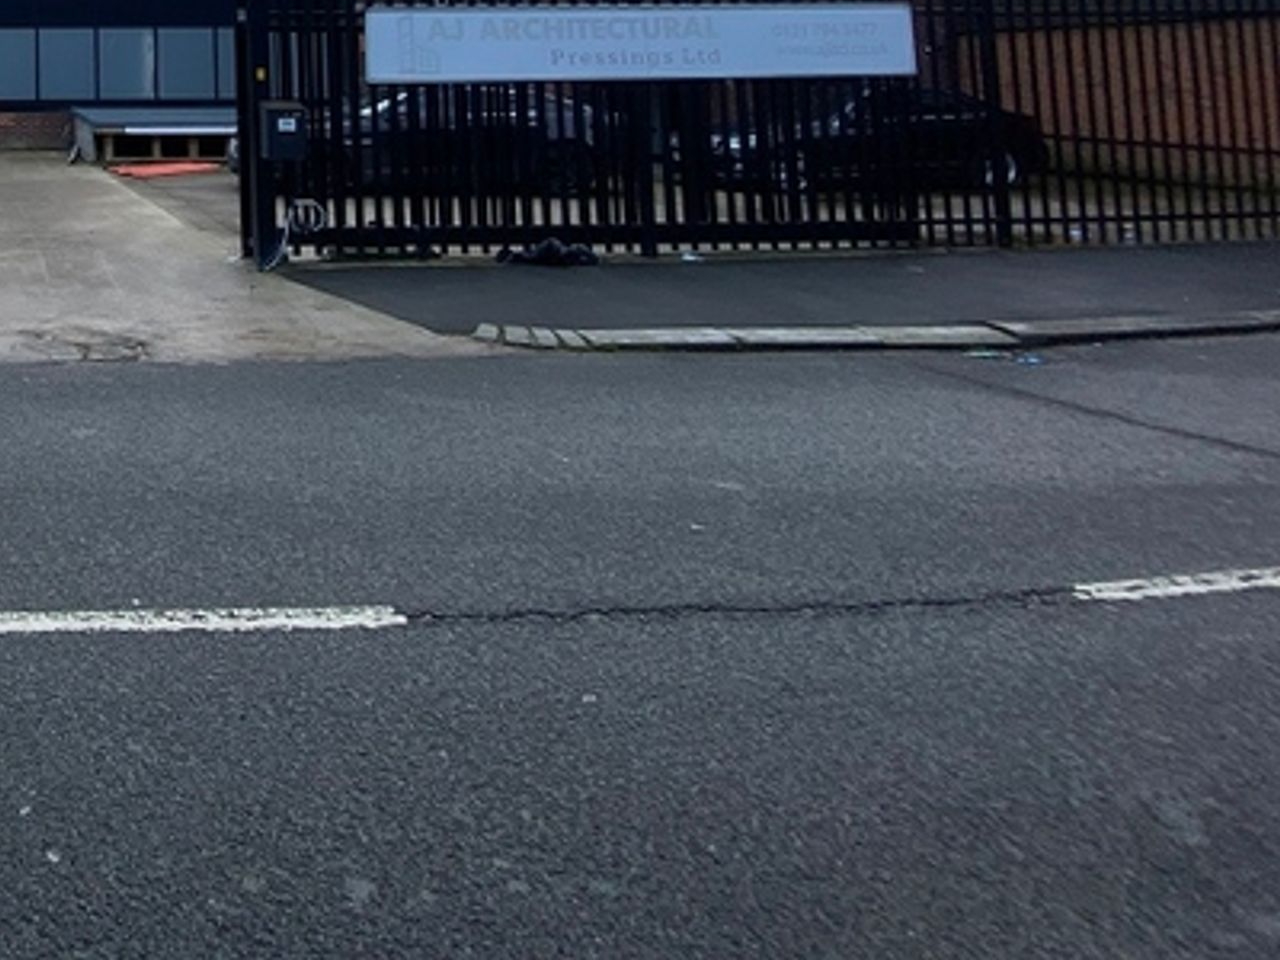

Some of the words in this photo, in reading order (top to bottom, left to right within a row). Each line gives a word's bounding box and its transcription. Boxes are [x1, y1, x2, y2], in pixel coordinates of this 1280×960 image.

[428, 17, 465, 40] AJ
[480, 16, 720, 40] ARCHITECTURAL
[550, 48, 675, 68] Pressings
[681, 47, 721, 66] Ltd
